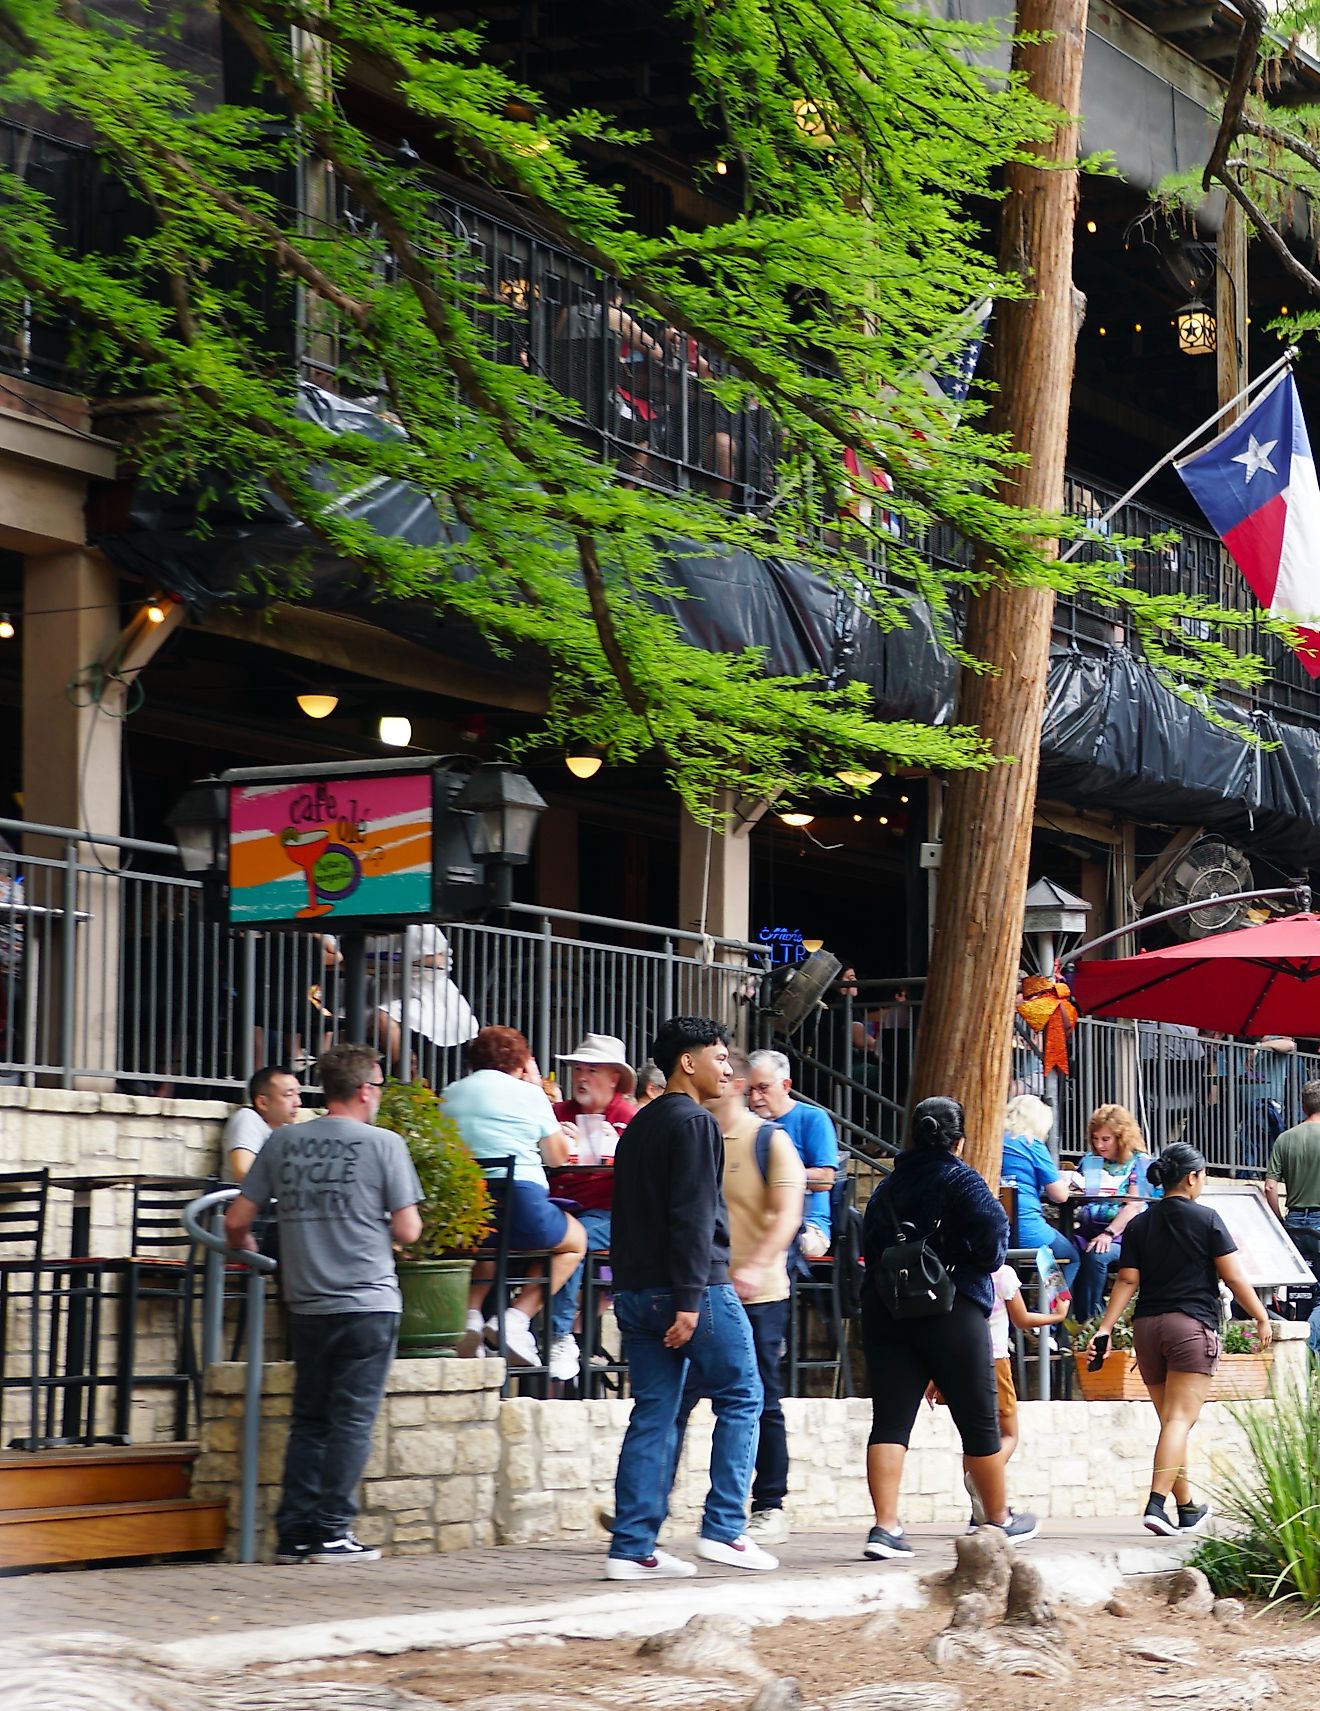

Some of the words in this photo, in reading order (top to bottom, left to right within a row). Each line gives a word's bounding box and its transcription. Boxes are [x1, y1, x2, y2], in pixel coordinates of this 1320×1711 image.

[281, 1138, 362, 1161] WOODS
[280, 1162, 357, 1186] CYCLE
[281, 1189, 353, 1212] COUNTRY
